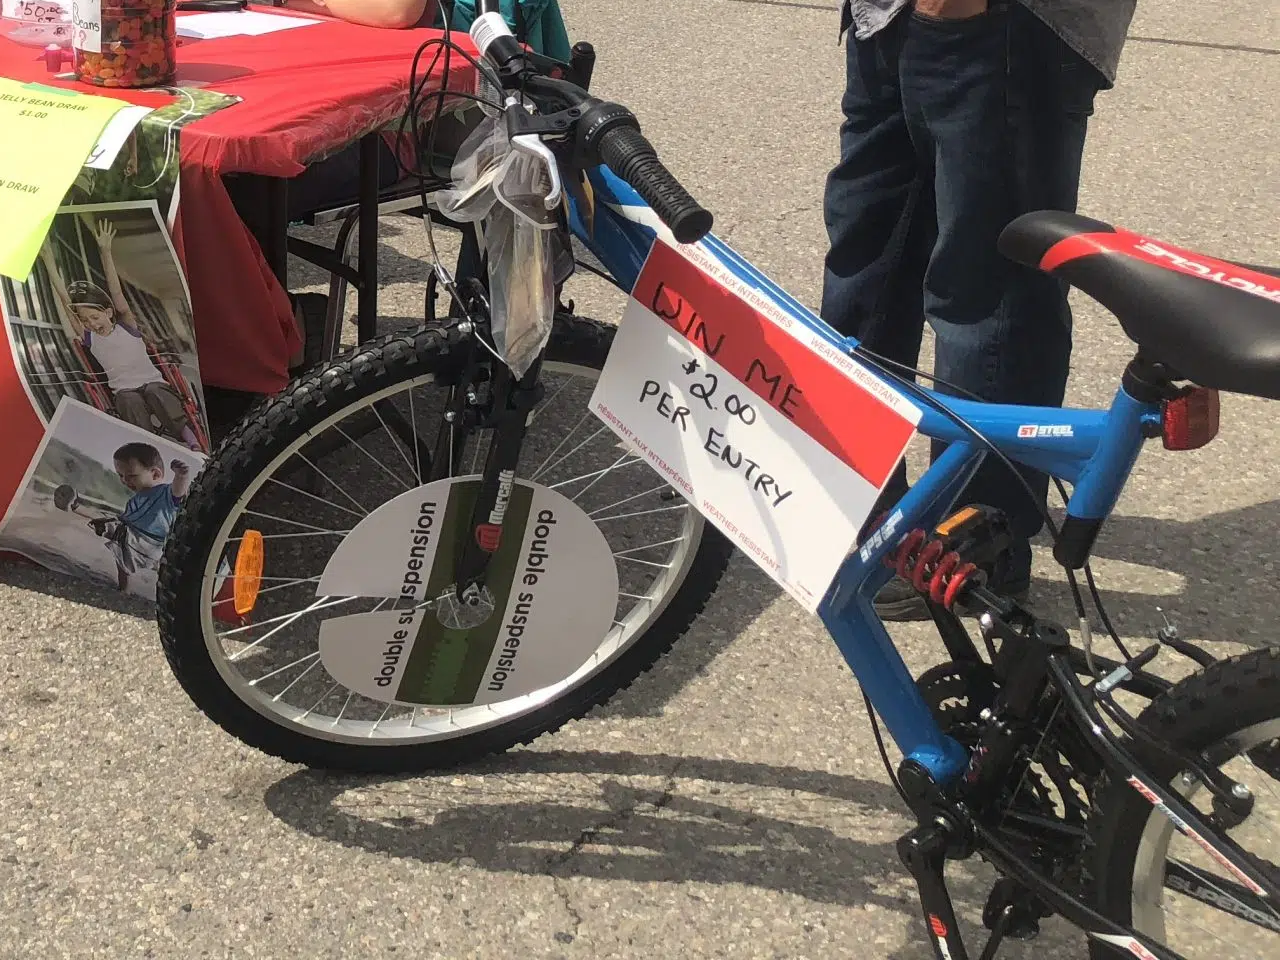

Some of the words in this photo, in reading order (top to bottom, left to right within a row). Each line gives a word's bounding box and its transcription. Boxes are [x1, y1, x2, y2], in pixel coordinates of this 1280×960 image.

[18, 109, 49, 119] $1.00
[28, 98, 56, 108] BEAN
[56, 102, 89, 112] DRAW
[6, 179, 40, 194] DRAW
[718, 271, 738, 290] AUX
[651, 281, 726, 357] WIN
[744, 358, 803, 419] ME
[810, 336, 855, 372] WEATHER
[853, 365, 902, 407] RESISTANT
[631, 436, 648, 453] AUX
[639, 380, 691, 432] PER
[703, 427, 793, 508] ENTRY
[523, 509, 557, 587] double
[702, 499, 739, 536] WEATHER
[737, 531, 782, 573] RESISTANT
[374, 629, 409, 687] double
[398, 501, 437, 624] suspension
[487, 592, 534, 691] suspension
